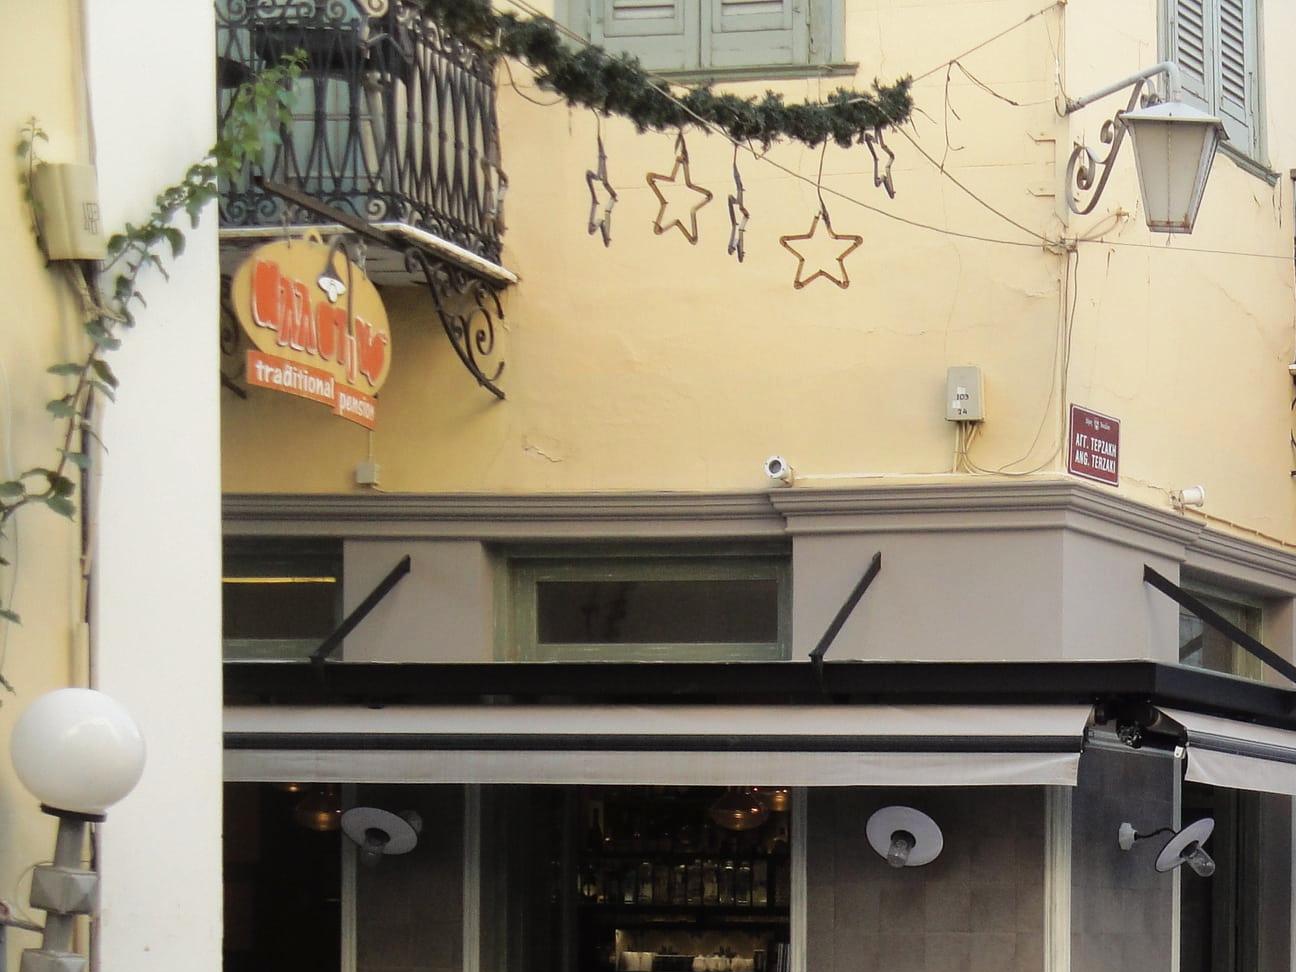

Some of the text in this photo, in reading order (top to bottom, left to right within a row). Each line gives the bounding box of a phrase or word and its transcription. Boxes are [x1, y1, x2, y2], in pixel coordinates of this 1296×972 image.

[255, 360, 335, 399] traditional
[338, 391, 376, 421] pension
[1090, 437, 1117, 458] ΤΕΡΖΑΚΗ
[1075, 450, 1117, 473] ANG. TERZAKI
